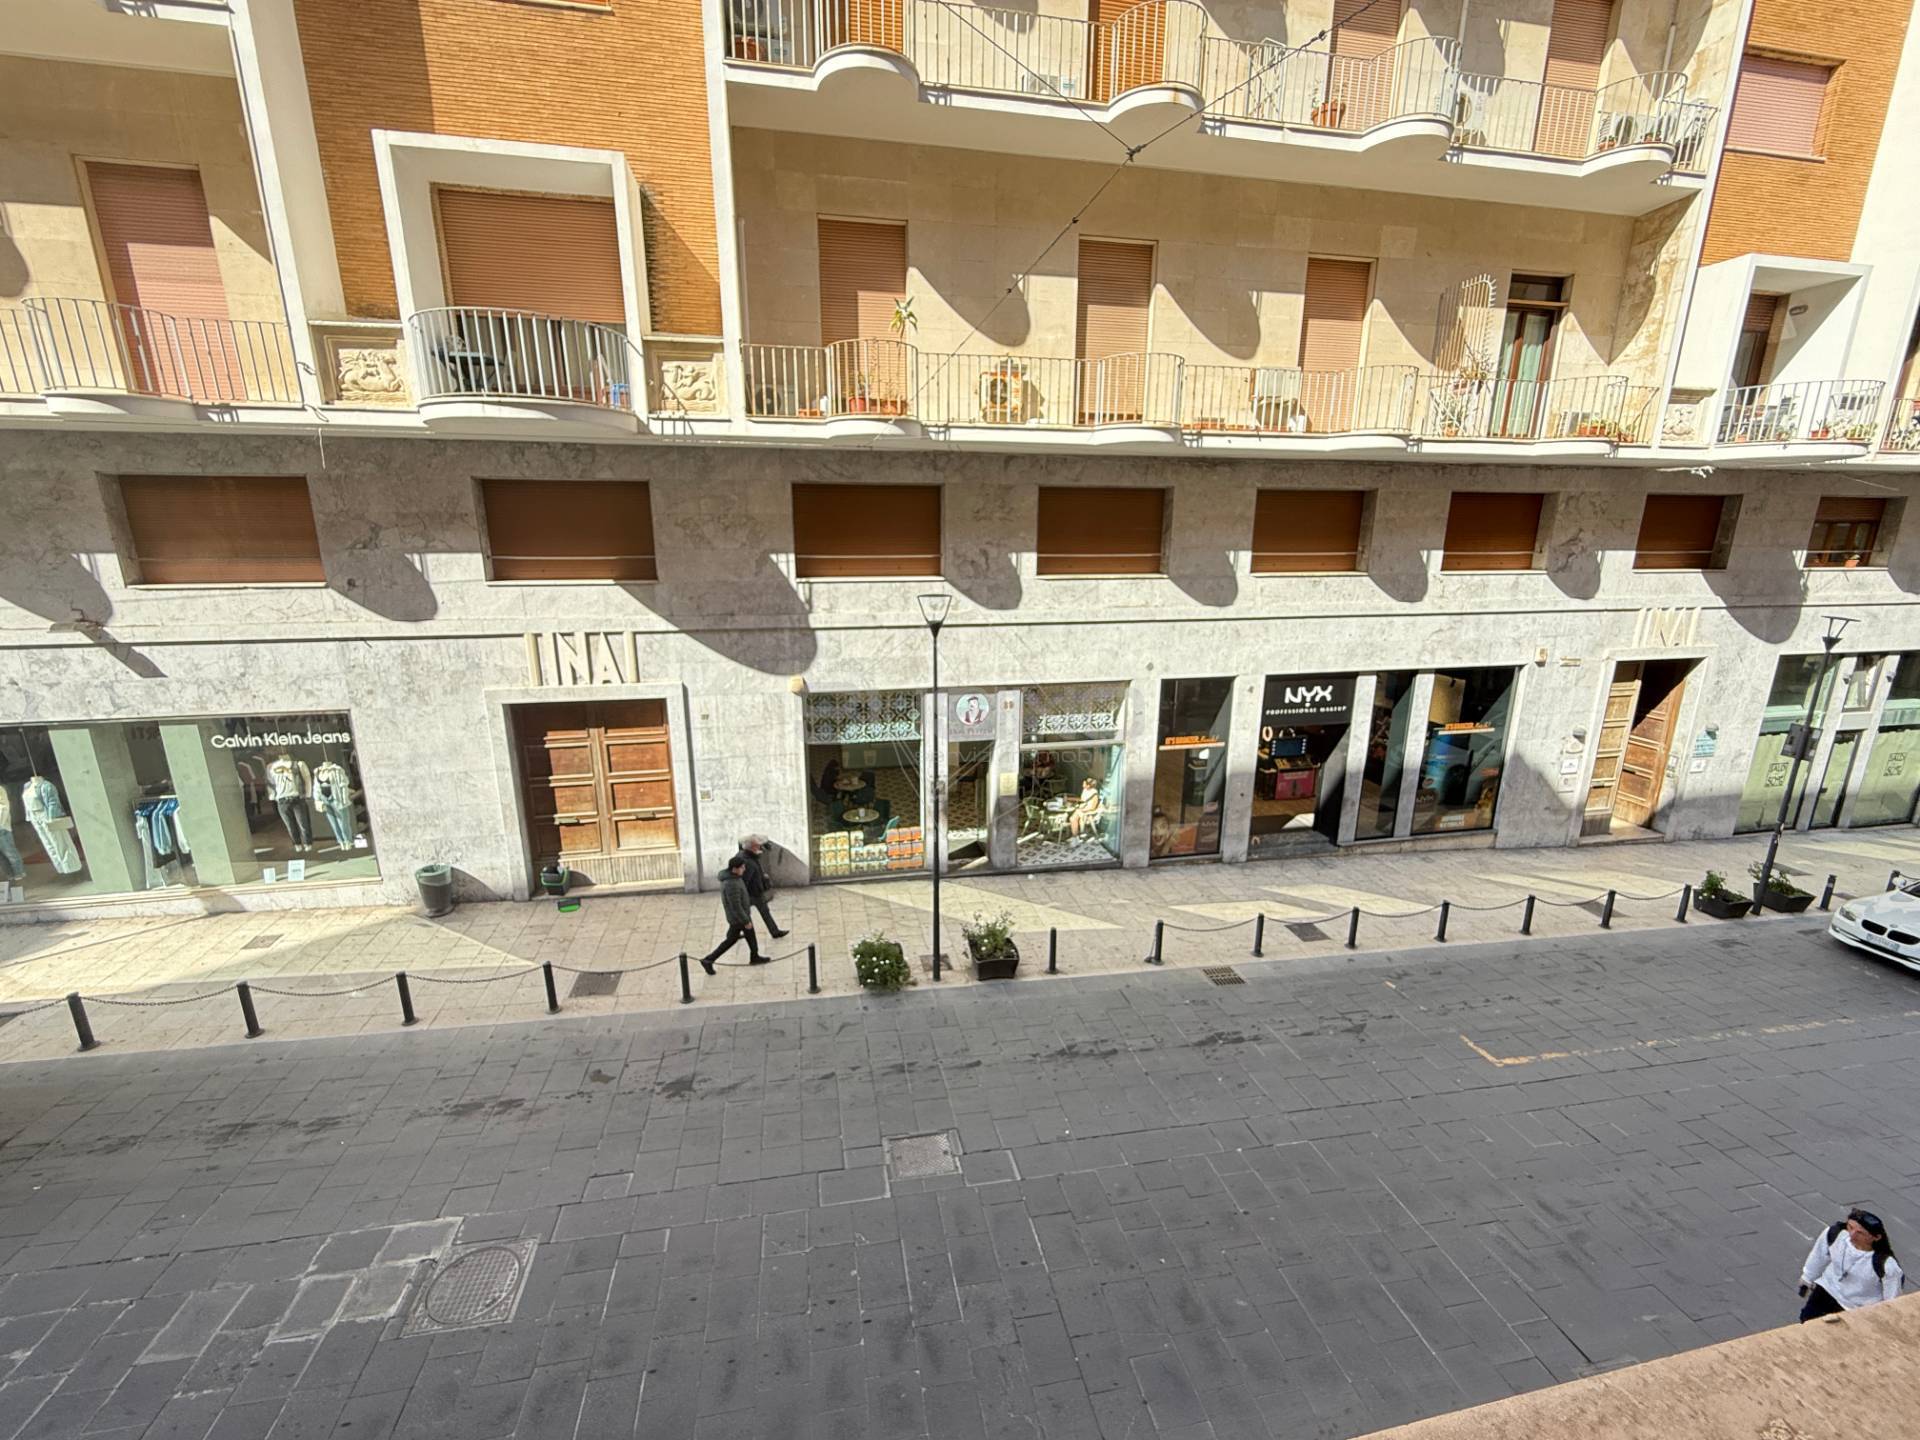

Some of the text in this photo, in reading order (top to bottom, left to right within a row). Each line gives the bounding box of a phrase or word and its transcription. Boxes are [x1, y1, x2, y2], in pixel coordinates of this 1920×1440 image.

[1284, 685, 1333, 707] NYX
[1265, 707, 1317, 715] PROFESSIONAL
[211, 731, 351, 748] Calvin Klein Jeans
